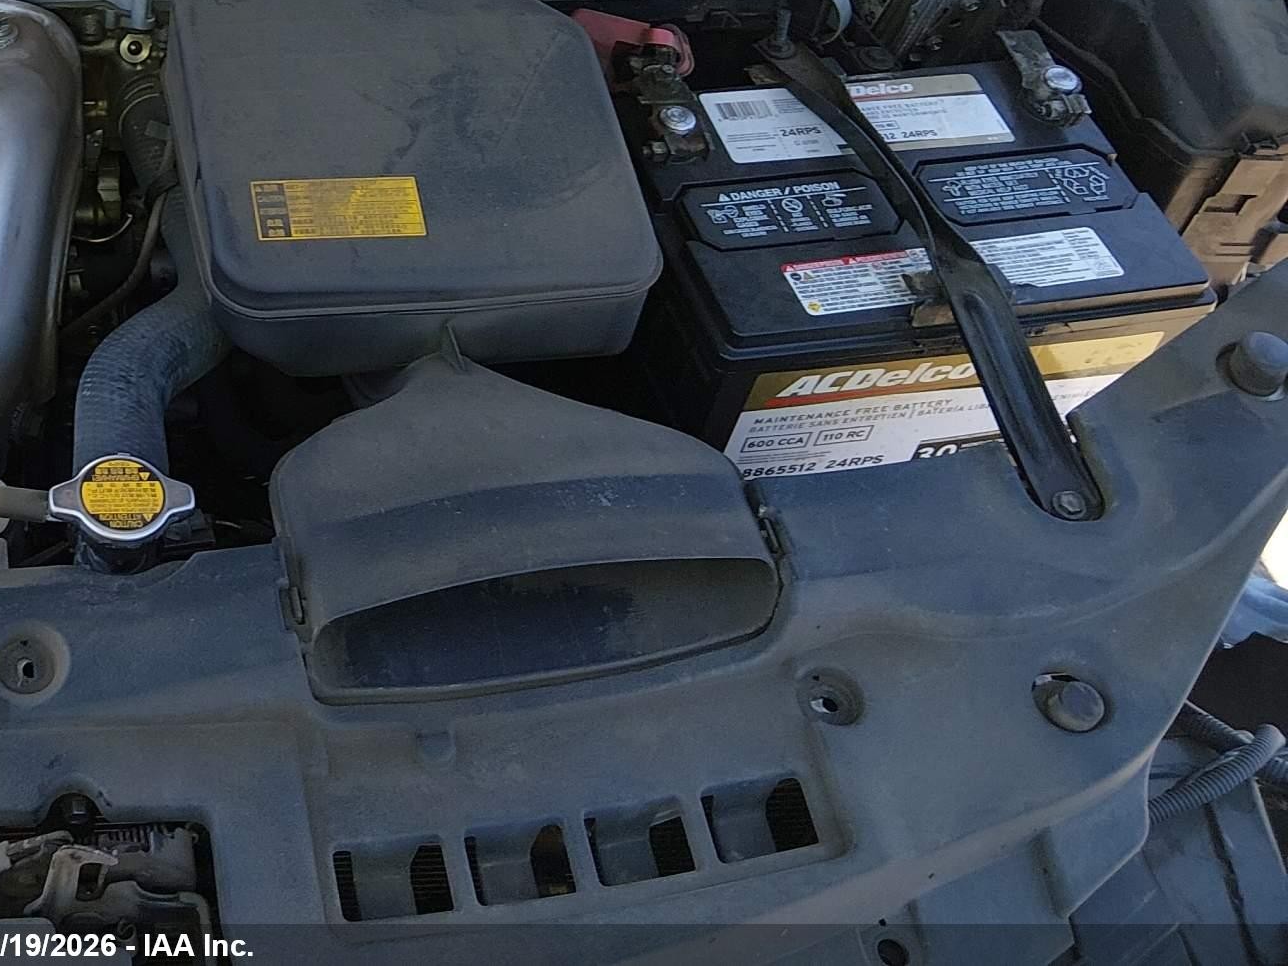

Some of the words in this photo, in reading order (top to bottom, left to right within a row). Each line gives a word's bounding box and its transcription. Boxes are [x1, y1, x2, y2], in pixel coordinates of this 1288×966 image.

[849, 83, 914, 96] Delco
[779, 126, 822, 137] 24RPS
[901, 129, 938, 139] 24RPS
[729, 187, 783, 202] DANGER
[793, 181, 840, 194] POISON
[775, 362, 977, 397] ACDelco
[753, 409, 851, 425] MAINTENANCE
[855, 405, 889, 415] FREE
[893, 399, 953, 411] BATTERY
[748, 422, 806, 433] BATTERIE
[808, 418, 838, 428] SANS
[841, 412, 907, 424] ENTRETIEN
[823, 432, 842, 441] 110
[846, 430, 865, 438] RC
[747, 439, 774, 449] 600
[777, 437, 804, 446] CCA
[824, 455, 885, 469] 24RPS
